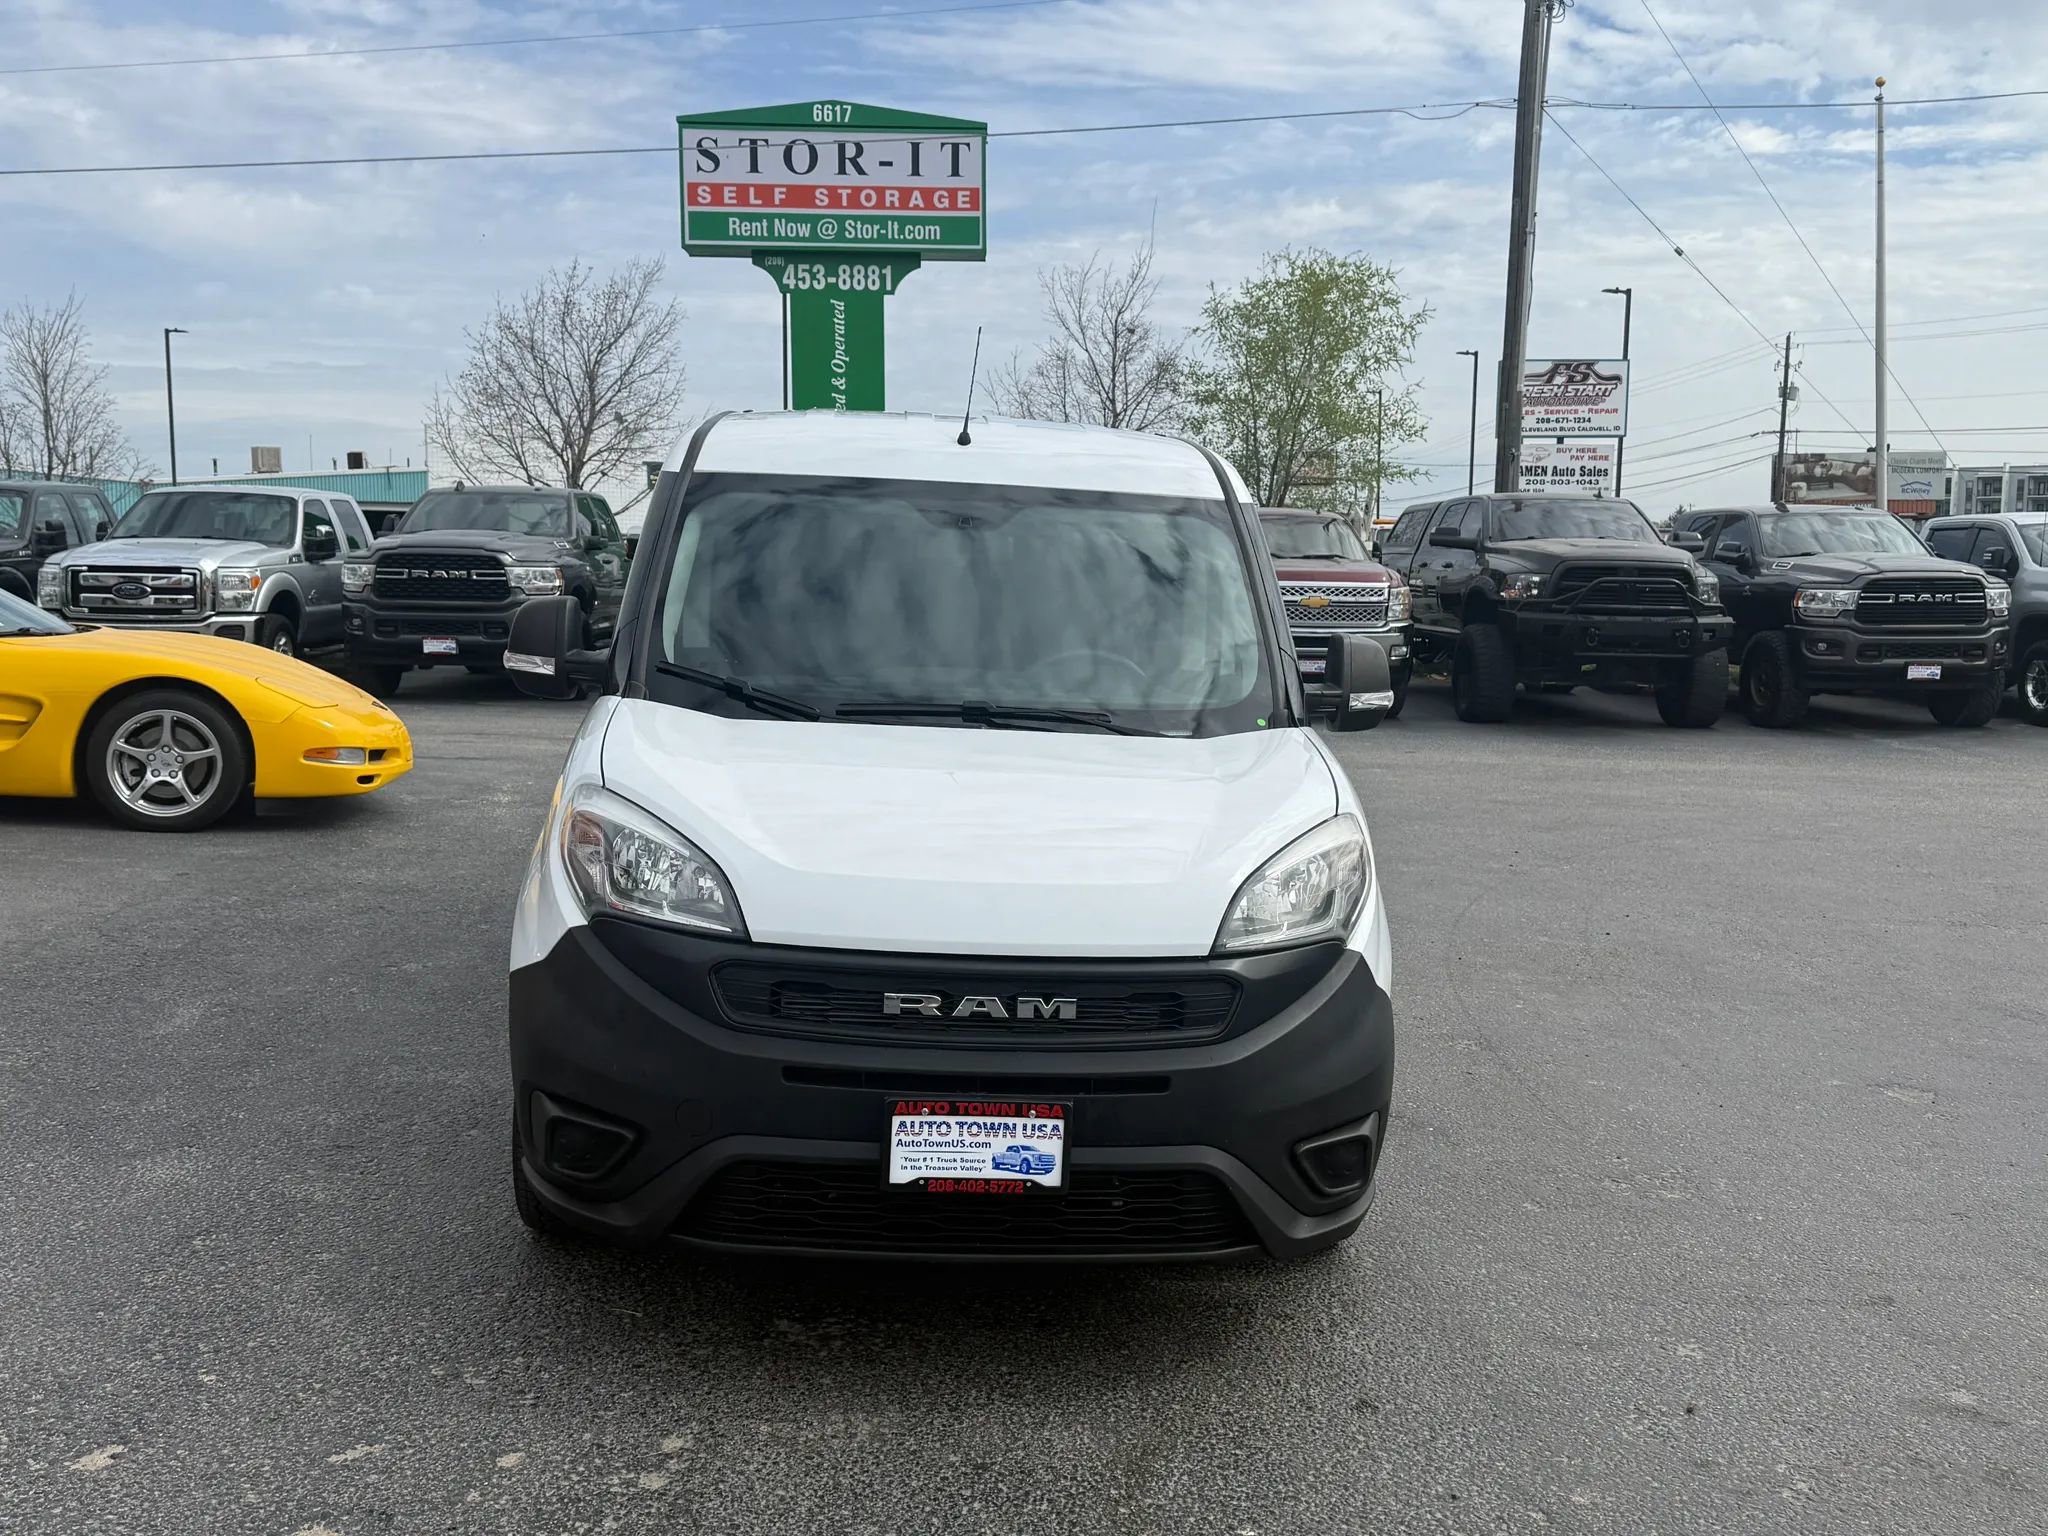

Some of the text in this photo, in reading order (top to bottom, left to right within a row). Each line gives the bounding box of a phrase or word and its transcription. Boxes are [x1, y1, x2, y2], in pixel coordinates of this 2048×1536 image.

[812, 104, 852, 123] 6617
[695, 136, 971, 178] STOR-IT
[696, 186, 972, 209] SELF STORAGE
[728, 217, 941, 240] Rent Now @ Stor-It.com
[782, 263, 893, 291] 453-8881
[830, 299, 849, 413] ed & Operated
[1523, 384, 1617, 397] RESH START
[1519, 465, 1609, 477] AMEN Auto Sales
[1525, 478, 1600, 486] 208-803-1043
[411, 570, 467, 578] RAM
[883, 992, 1078, 1020] RAM
[894, 1101, 1064, 1118] AUTO TOWN USA
[895, 1120, 1062, 1140] AUTO TOWN USA
[896, 1138, 992, 1149] AutoTownUS.com
[925, 1165, 958, 1173] Treasure
[960, 1157, 986, 1165] Source
[928, 1180, 1024, 1194] 208-402-5772
